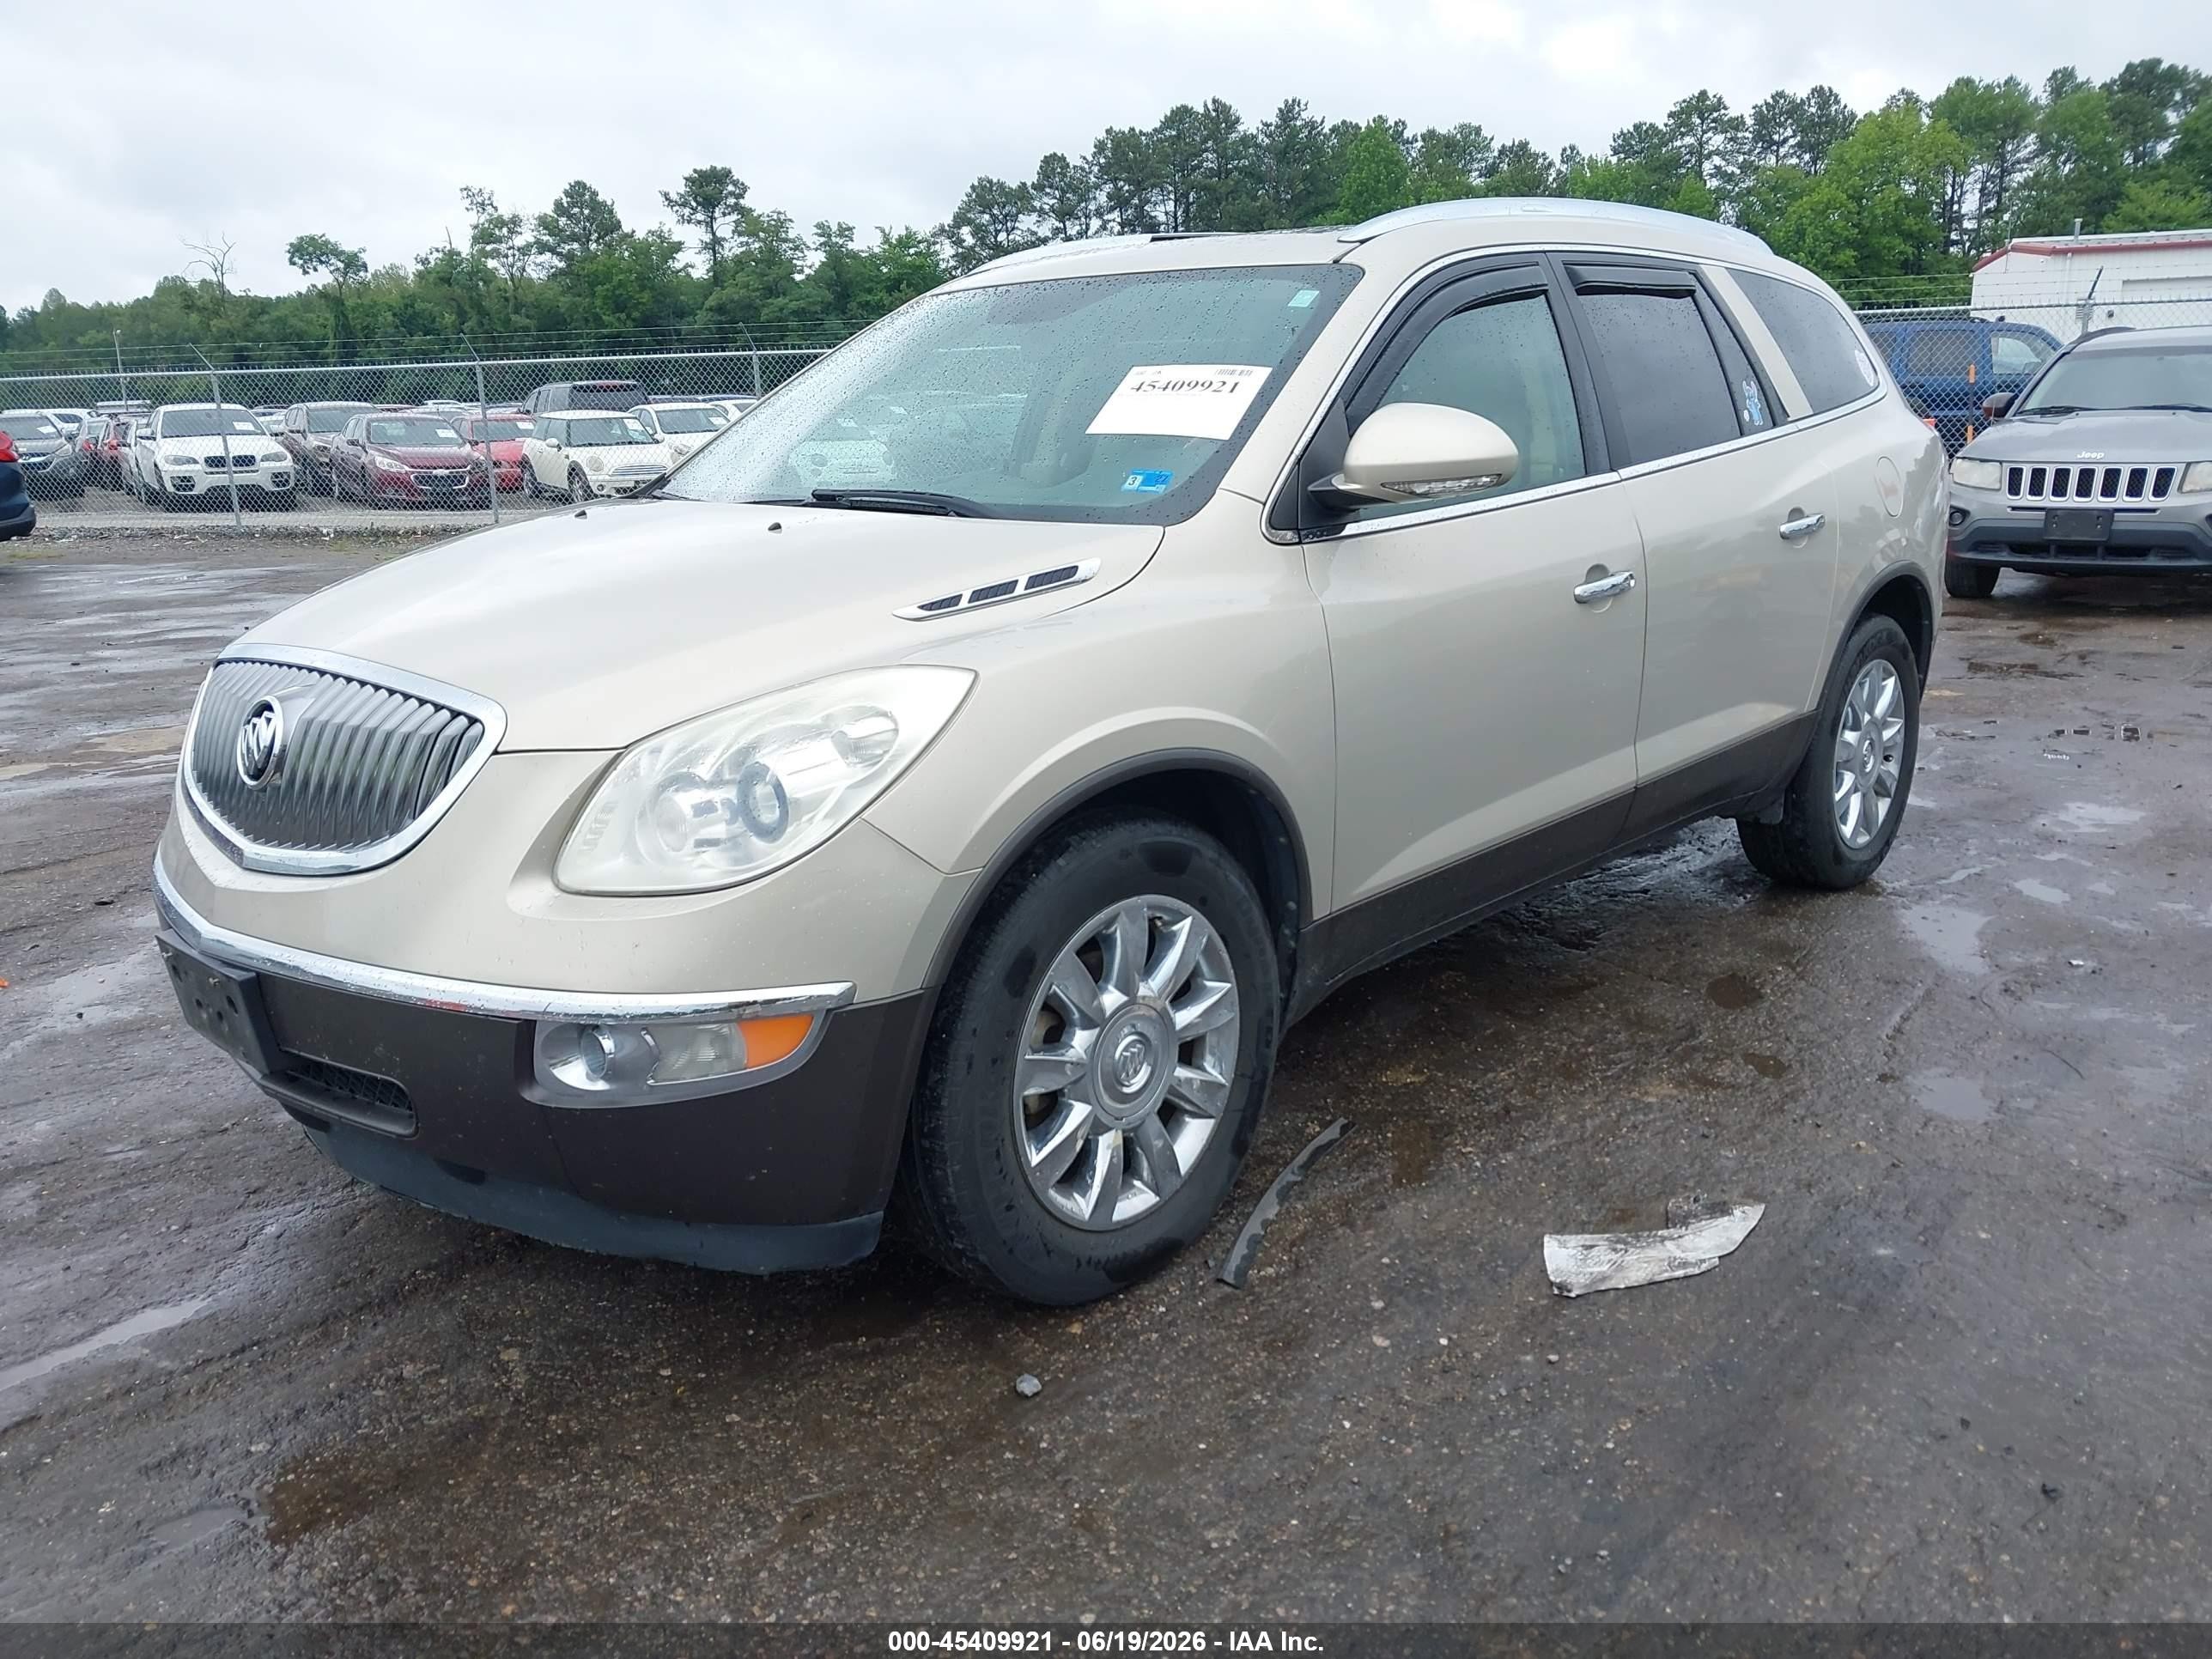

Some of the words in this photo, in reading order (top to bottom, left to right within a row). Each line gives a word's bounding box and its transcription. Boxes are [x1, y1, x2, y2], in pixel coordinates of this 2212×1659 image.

[1130, 379, 1241, 394] 45409921
[2076, 451, 2105, 460] Jeep
[1127, 476, 1139, 486] 3
